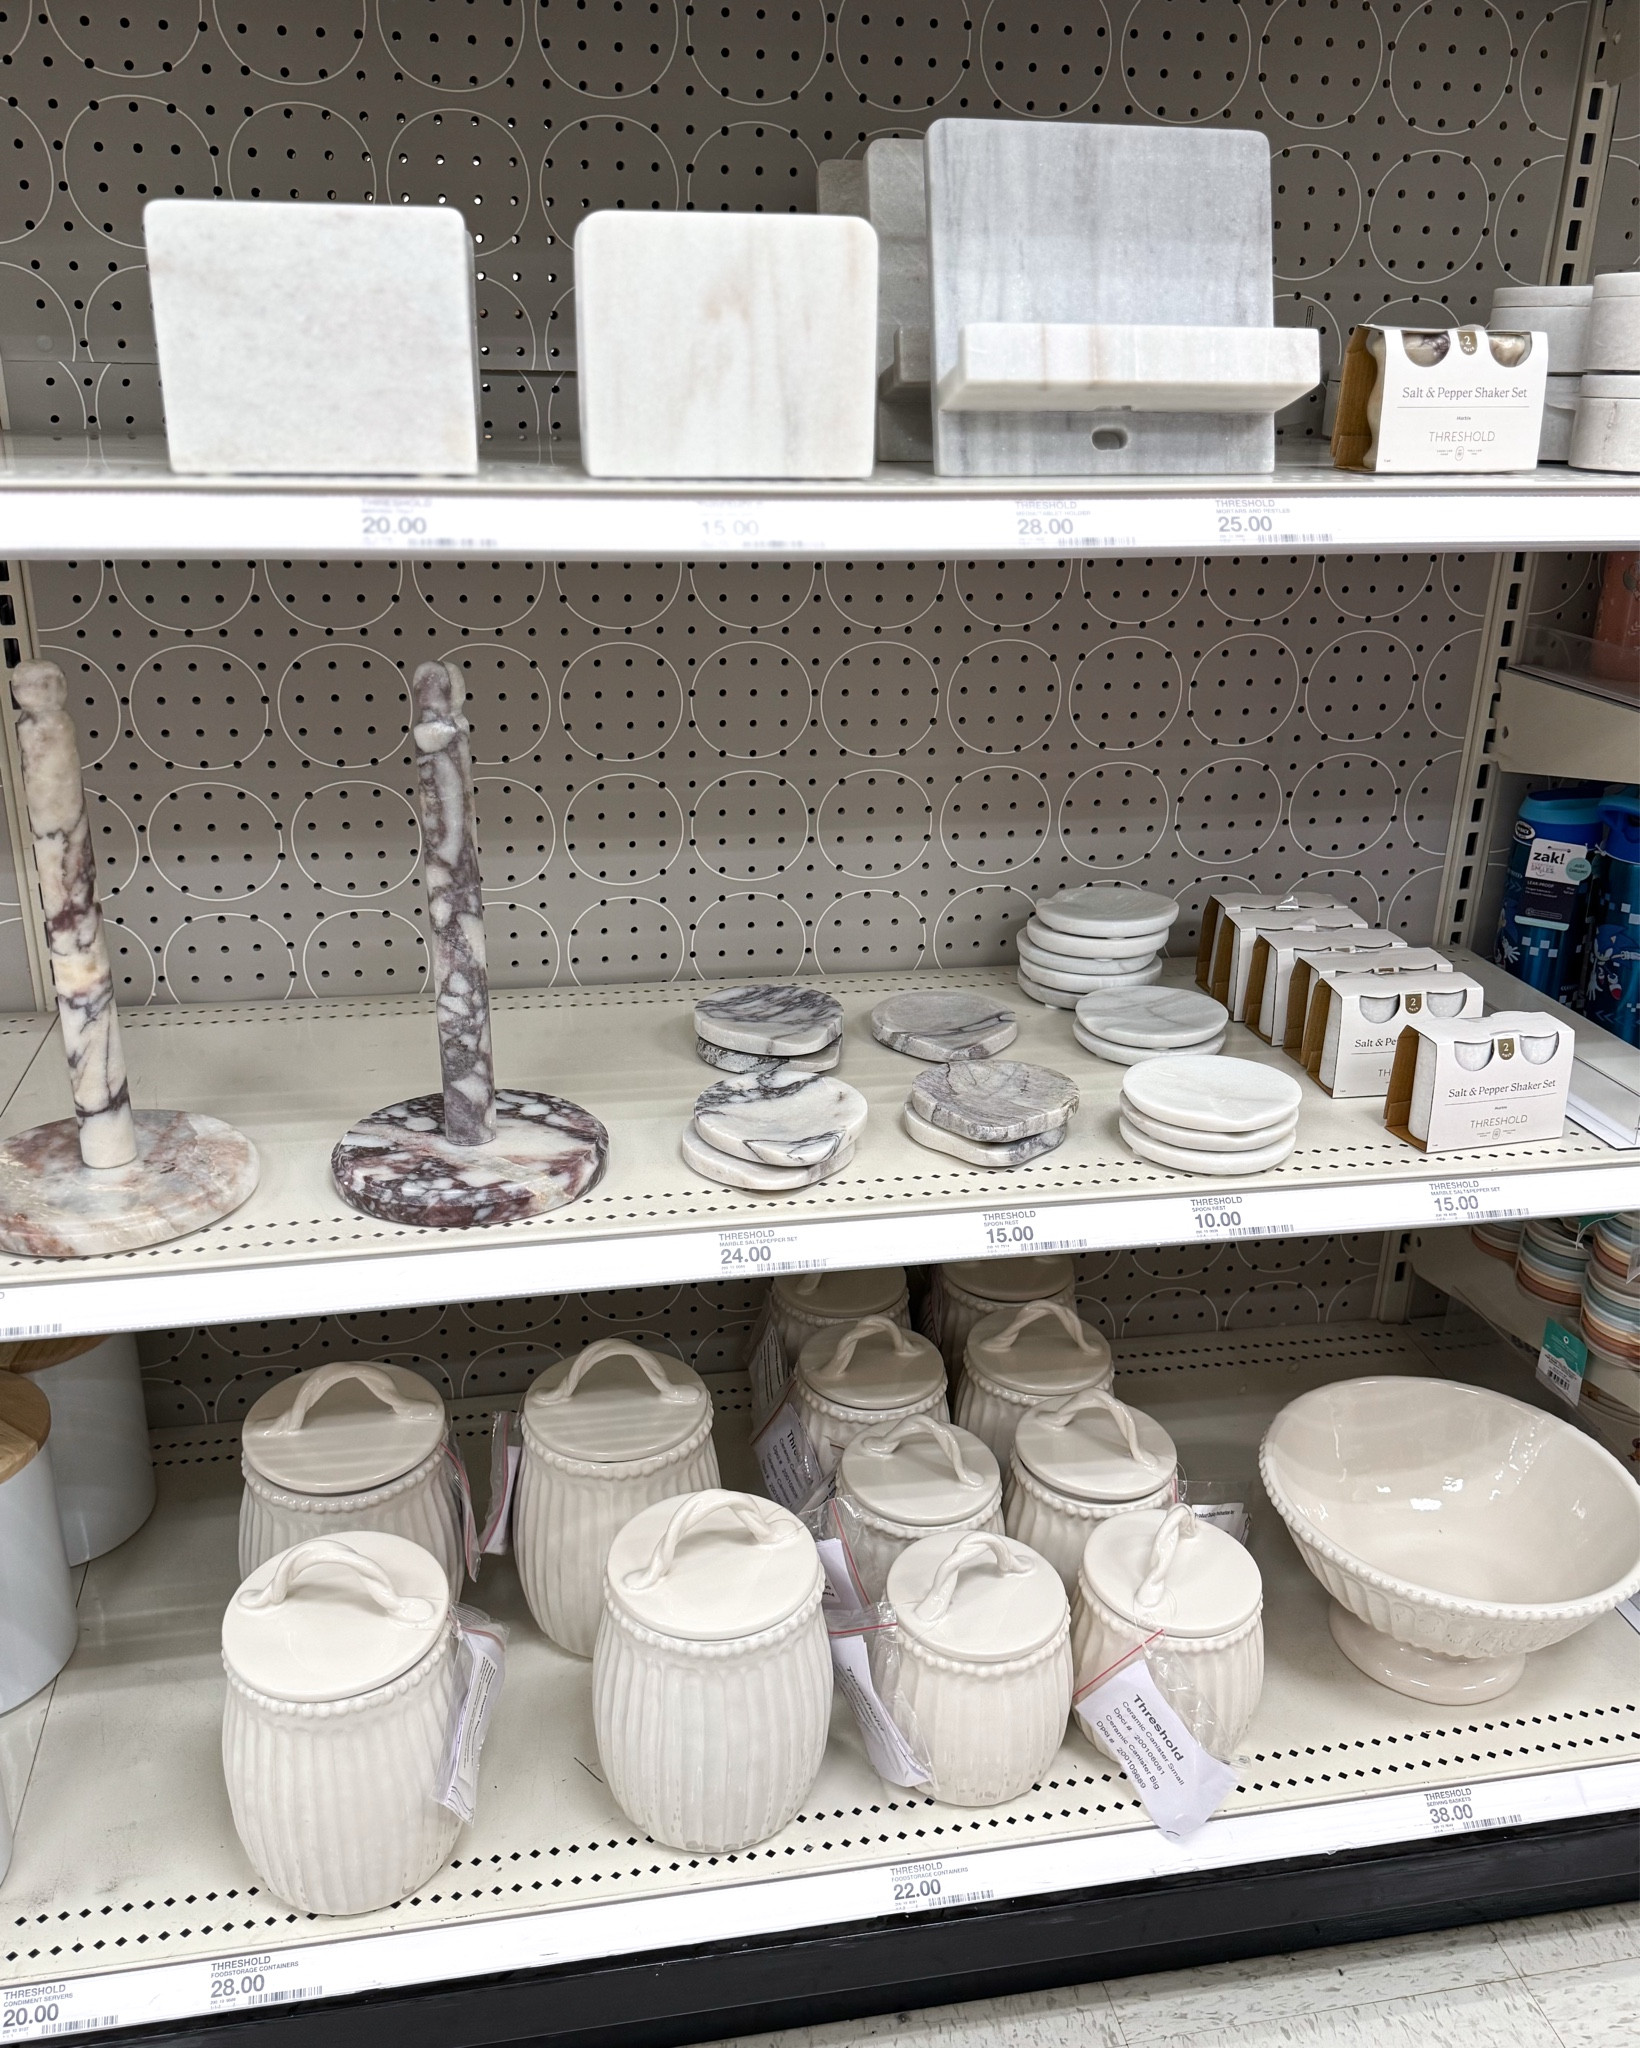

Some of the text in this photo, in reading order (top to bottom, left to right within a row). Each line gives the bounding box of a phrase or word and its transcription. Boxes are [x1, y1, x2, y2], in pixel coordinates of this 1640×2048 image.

[1464, 336, 1471, 345] 2
[1402, 386, 1527, 400] Salt & Pepper Shaker Set
[1429, 431, 1496, 442] THRESHOLD
[1016, 501, 1077, 510] THRESHOLD
[1215, 499, 1275, 508] THRESHOLD
[362, 516, 427, 534] 20.00
[701, 519, 759, 536] 1500
[1017, 518, 1074, 535] 28.00
[1217, 515, 1273, 532] 25.00
[1533, 852, 1565, 864] zak!
[1410, 998, 1416, 1006] 2
[1354, 1037, 1373, 1048] Salt
[1375, 1038, 1384, 1047] &
[1503, 1042, 1509, 1052] 2
[1448, 1079, 1556, 1098] Salt & Pepper Shaker Set
[1470, 1114, 1528, 1128] THRESHOLD
[1429, 1180, 1480, 1190] THRESHOLD
[1190, 1196, 1243, 1207] THRESHOLD
[1434, 1195, 1479, 1212] 15.00
[982, 1210, 1036, 1221] THRESHOLD
[1195, 1211, 1242, 1228] 10.00
[984, 1220, 1004, 1228] SPOON
[718, 1229, 775, 1242] THRESHOLD
[986, 1226, 1034, 1244] 15.00
[720, 1245, 772, 1264] 24.00
[1113, 1707, 1127, 1727] Dpci
[1096, 1720, 1110, 1740] Dpci
[1133, 1694, 1184, 1762] Threshold
[1122, 1701, 1185, 1786] Ceramic Canister Small
[1105, 1714, 1160, 1790] Ceramic Canister Big
[1424, 1788, 1472, 1801] THRESHOLD
[1430, 1804, 1474, 1824] 38.00
[890, 1862, 943, 1876] THRESHOLD
[892, 1867, 969, 1882] FOODSTORAGE CONTAINERS
[894, 1878, 942, 1900] 22.00
[210, 1960, 299, 1978] FOODSTORAGE CONTAINERS
[211, 1955, 271, 1972] THRESHOLD
[4, 1984, 66, 2000] THRESHOLD
[210, 1974, 265, 1998] 28.00
[4, 1992, 74, 2008] CONDIMENT SERVERS
[2, 2002, 60, 2028] 20.00
